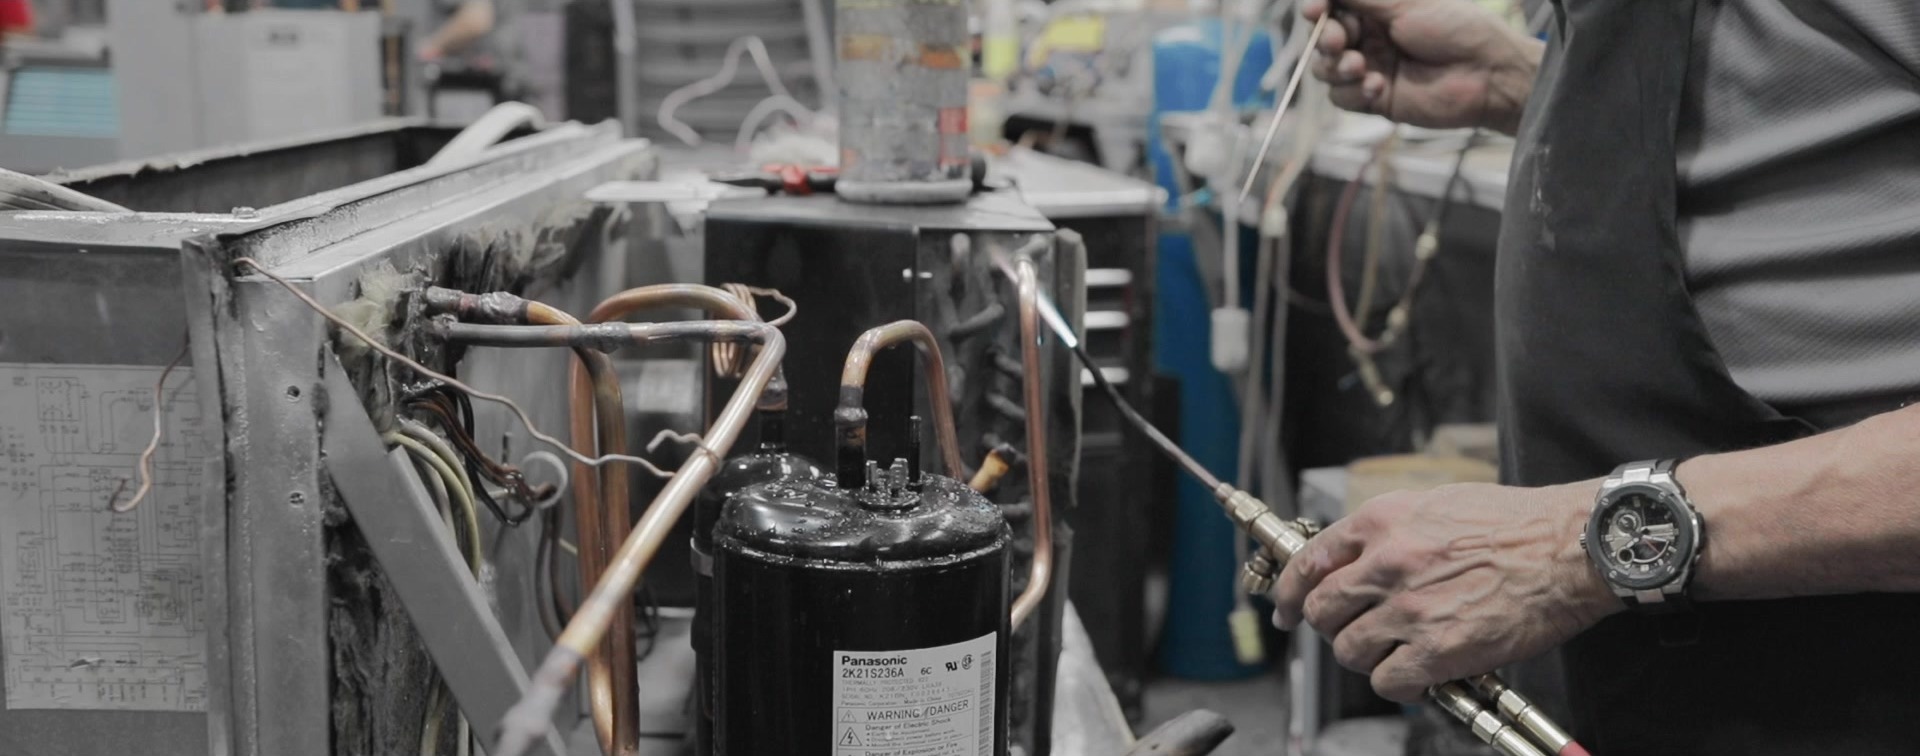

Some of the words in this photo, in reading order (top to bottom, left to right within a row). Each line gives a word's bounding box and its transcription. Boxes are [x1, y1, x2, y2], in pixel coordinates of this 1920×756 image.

[842, 654, 907, 666] Panasonic
[842, 667, 904, 678] 2K21S236A
[920, 667, 932, 675] 6C
[904, 720, 929, 728] Electric
